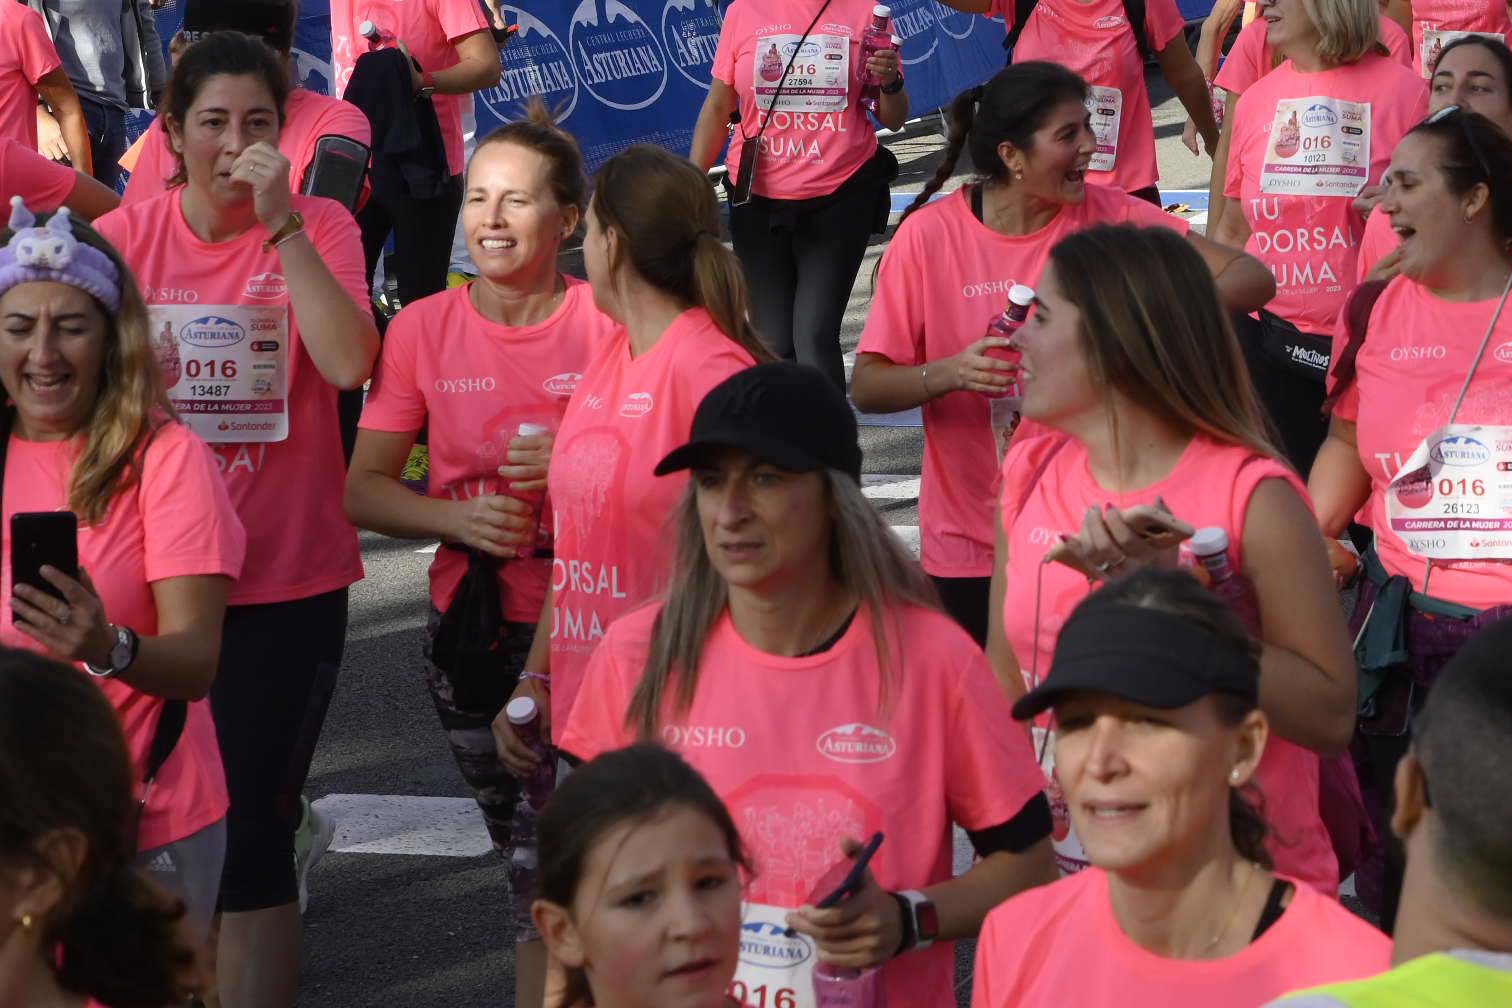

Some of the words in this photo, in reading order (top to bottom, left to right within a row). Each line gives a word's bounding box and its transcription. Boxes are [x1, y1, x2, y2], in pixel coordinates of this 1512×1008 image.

[580, 40, 663, 85] ASTURIANA
[787, 64, 816, 75] 016
[788, 78, 813, 86] 27594
[758, 112, 847, 132] DORSAL
[759, 135, 822, 157] SUMA
[1303, 135, 1332, 151] 016
[1303, 153, 1327, 164] 10123
[1249, 196, 1279, 222] TU
[1272, 261, 1337, 287] UMA
[963, 279, 1018, 298] OYSHO
[185, 328, 240, 340] ASTURIANA
[1390, 345, 1446, 361] OYSHO
[185, 359, 238, 378] 016
[190, 384, 232, 398] 13487
[434, 376, 496, 394] OYSHO
[230, 421, 277, 432] Santander
[1435, 446, 1487, 460] ASTURIANA
[1438, 478, 1485, 497] 016
[1443, 503, 1480, 515] 26123
[1405, 520, 1445, 530] CARRERA
[1447, 521, 1458, 529] DE
[1459, 521, 1471, 529] LA
[1472, 521, 1501, 530] MUJER
[661, 725, 746, 749] OYSHO
[821, 738, 890, 755] ASTURIANA
[739, 939, 803, 961] STURIANA
[727, 981, 797, 1008] 016
